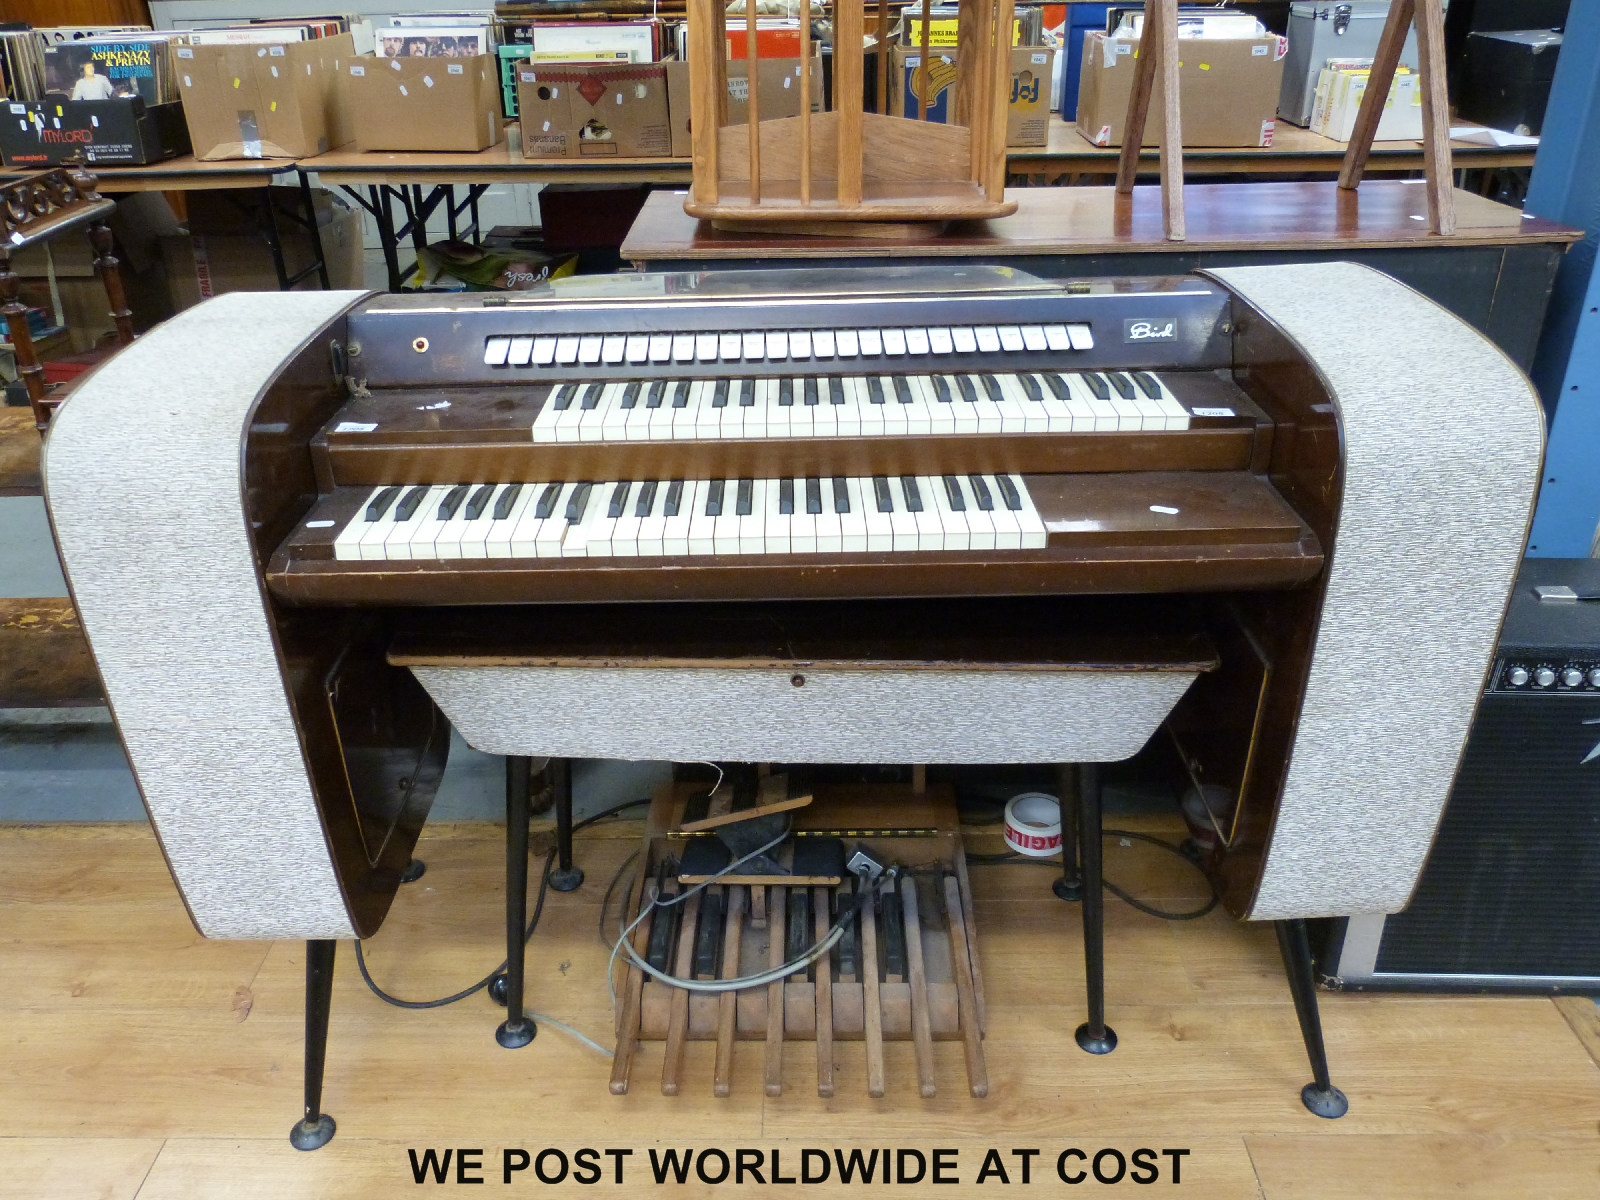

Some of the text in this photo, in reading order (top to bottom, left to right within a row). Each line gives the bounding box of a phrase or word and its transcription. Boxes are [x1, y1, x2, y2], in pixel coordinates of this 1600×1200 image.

[92, 50, 150, 60] ASHKENAZY
[116, 58, 150, 66] PREVIN
[529, 135, 566, 145] Bananas
[530, 146, 567, 155] Premium
[504, 266, 549, 287] fresh
[1130, 322, 1173, 339] Bird
[1005, 822, 1063, 851] AGILE
